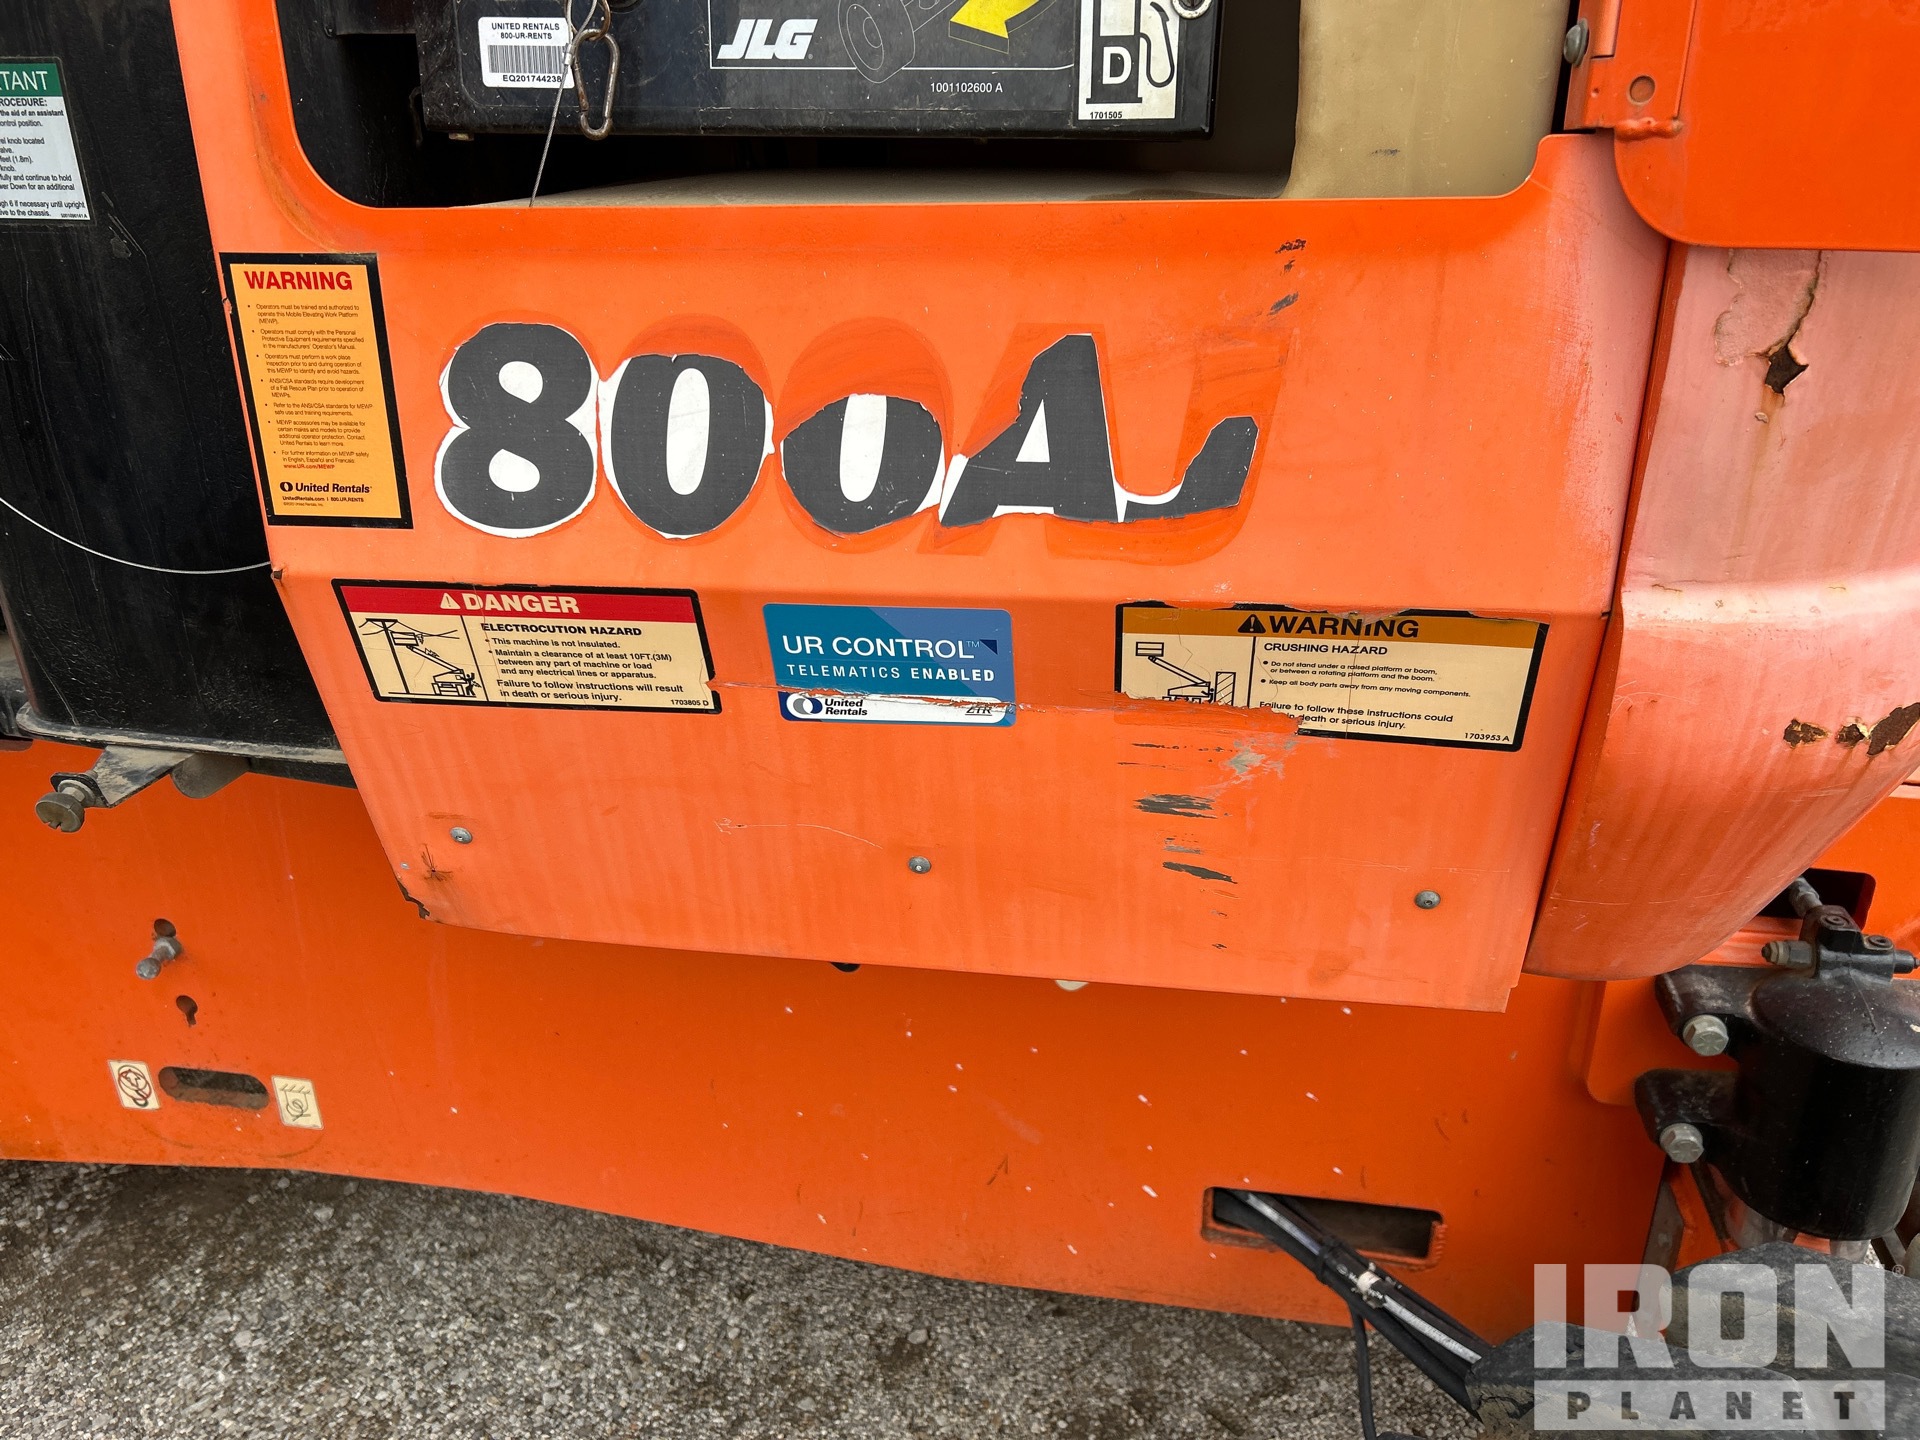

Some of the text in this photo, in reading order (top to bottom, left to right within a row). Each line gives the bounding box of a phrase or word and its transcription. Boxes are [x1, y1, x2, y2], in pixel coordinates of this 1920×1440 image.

[491, 22, 560, 31] UNITED RENTALS
[500, 32, 553, 40] 800-UR-RENTS
[716, 18, 818, 60] JLG
[1102, 46, 1132, 85] D
[930, 82, 1004, 93] 1001102600 A
[1089, 111, 1123, 119] 1701505
[18, 120, 43, 128] position.
[19, 201, 49, 209] necessary
[244, 270, 353, 291] WARNING
[256, 303, 280, 311] Operators
[303, 311, 324, 319] Elevating
[260, 328, 284, 336] Operators
[295, 482, 370, 494] United Rentals
[461, 592, 580, 614] DANGER
[480, 623, 642, 636] ELECTROCUTION HAZARD
[1269, 615, 1419, 638] WARNING
[491, 637, 512, 645] This
[513, 638, 550, 647] machine
[551, 639, 560, 647] is
[577, 640, 621, 648] insulated.
[782, 635, 824, 655] UR
[1263, 642, 1388, 655] CRUSHING HAZARD
[495, 649, 532, 657] Maintain
[541, 650, 583, 658] clearance
[584, 651, 594, 659] of
[606, 652, 628, 660] least
[629, 653, 672, 662] 10FT.(3M)
[498, 658, 534, 666] between
[553, 660, 571, 668] part
[583, 661, 620, 669] machine
[501, 667, 517, 675] and
[518, 669, 534, 677] any
[576, 669, 598, 677] lines
[610, 671, 657, 679] apparatus.
[786, 664, 995, 682] TELEMATICS ENABLED
[1413, 667, 1438, 675] boom,
[496, 679, 684, 693] Failure to follow instructions will result
[1299, 680, 1318, 688] body
[1423, 689, 1471, 697] components.
[499, 689, 510, 697] in
[511, 690, 539, 698] death
[553, 692, 590, 700] serious
[591, 692, 622, 702] injury.
[824, 698, 863, 708] United
[825, 707, 868, 716] Rentals
[1294, 703, 1304, 711] to
[1306, 704, 1335, 713] follow
[1337, 706, 1365, 716] these
[1366, 708, 1422, 720] instructions
[1424, 714, 1454, 722] could
[1341, 717, 1376, 726] serious
[1377, 719, 1406, 730] injury.
[1464, 732, 1501, 741] 1703953
